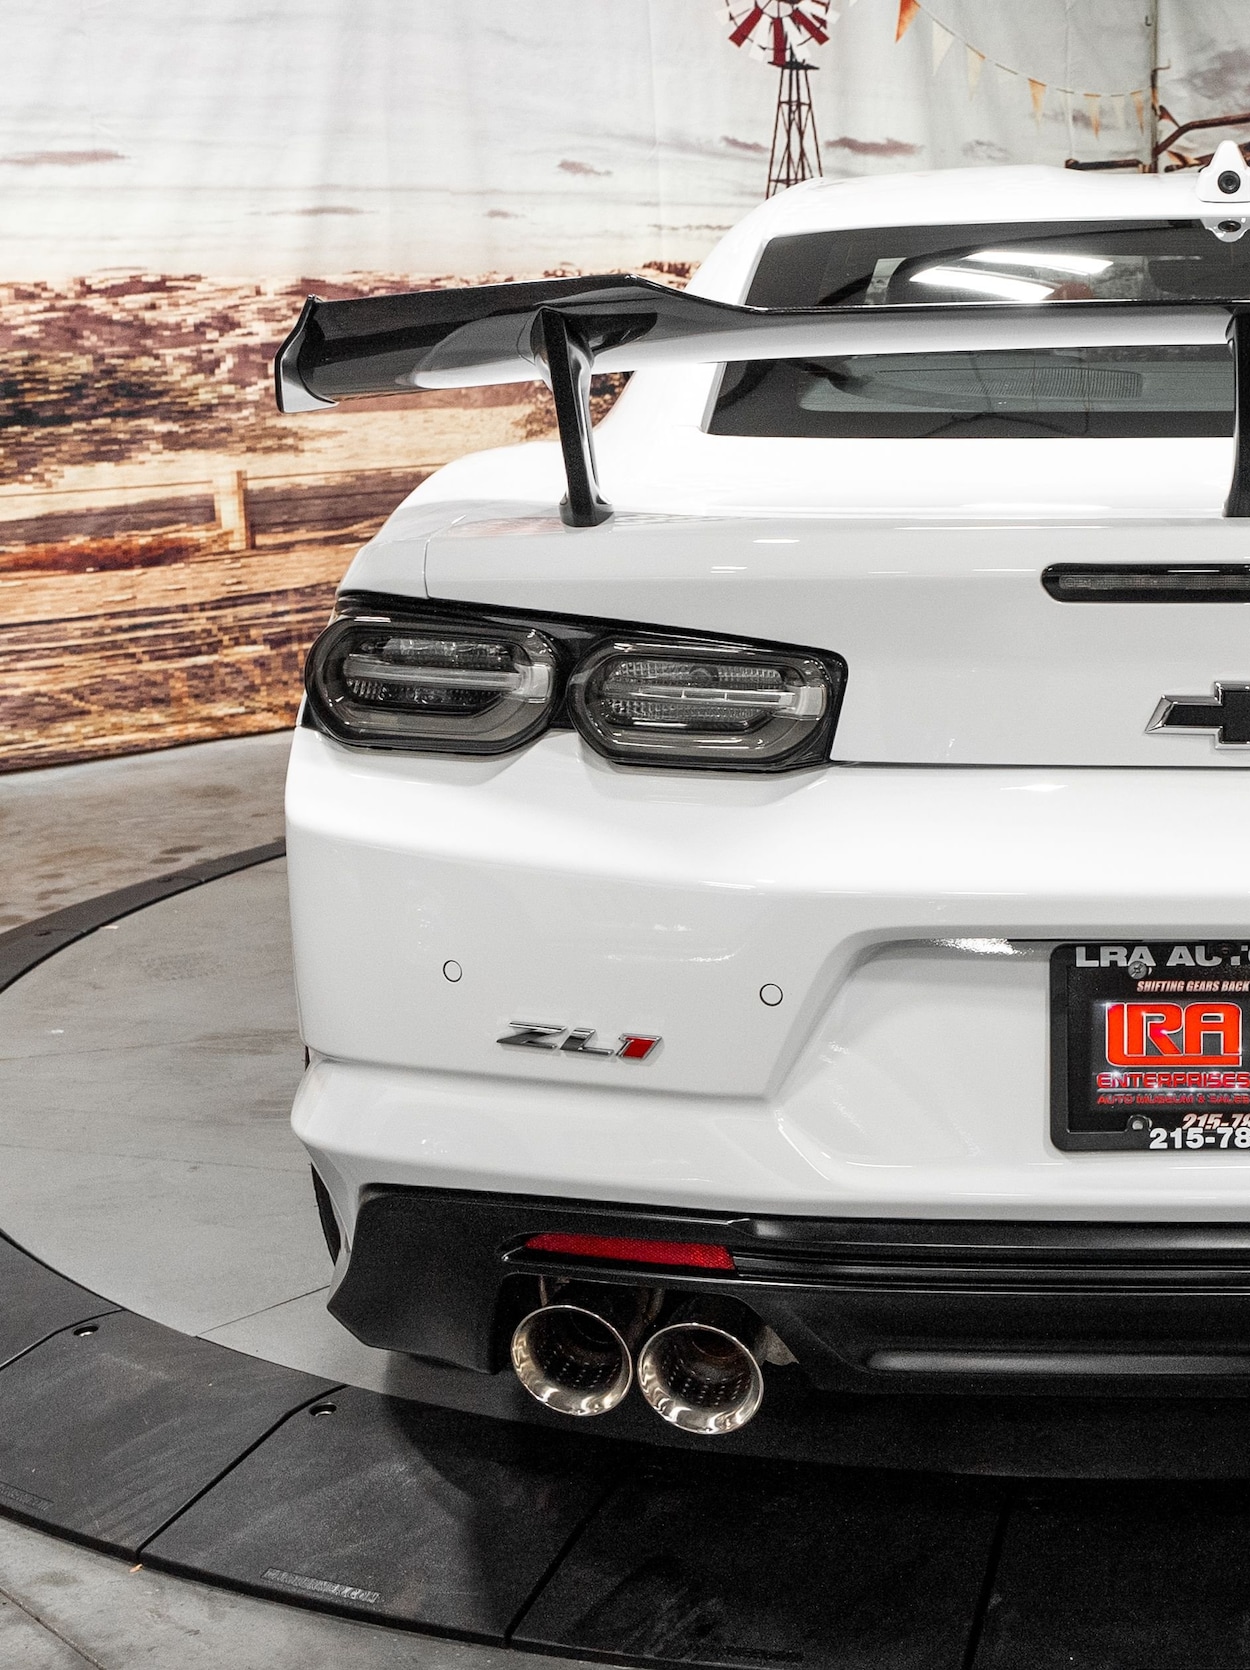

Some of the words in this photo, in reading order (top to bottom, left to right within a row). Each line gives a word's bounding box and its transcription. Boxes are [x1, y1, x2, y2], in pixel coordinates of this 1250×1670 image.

[1075, 945, 1157, 968] LRA
[1136, 979, 1185, 993] SHIFTING
[1185, 979, 1220, 993] GEARS
[1220, 979, 1250, 993] BACK
[496, 1020, 663, 1060] ZL1
[1106, 1002, 1243, 1067] LRA
[1097, 1094, 1134, 1105] AUTO
[1136, 1094, 1194, 1104] MUSEUM
[1208, 1093, 1250, 1105] SALES
